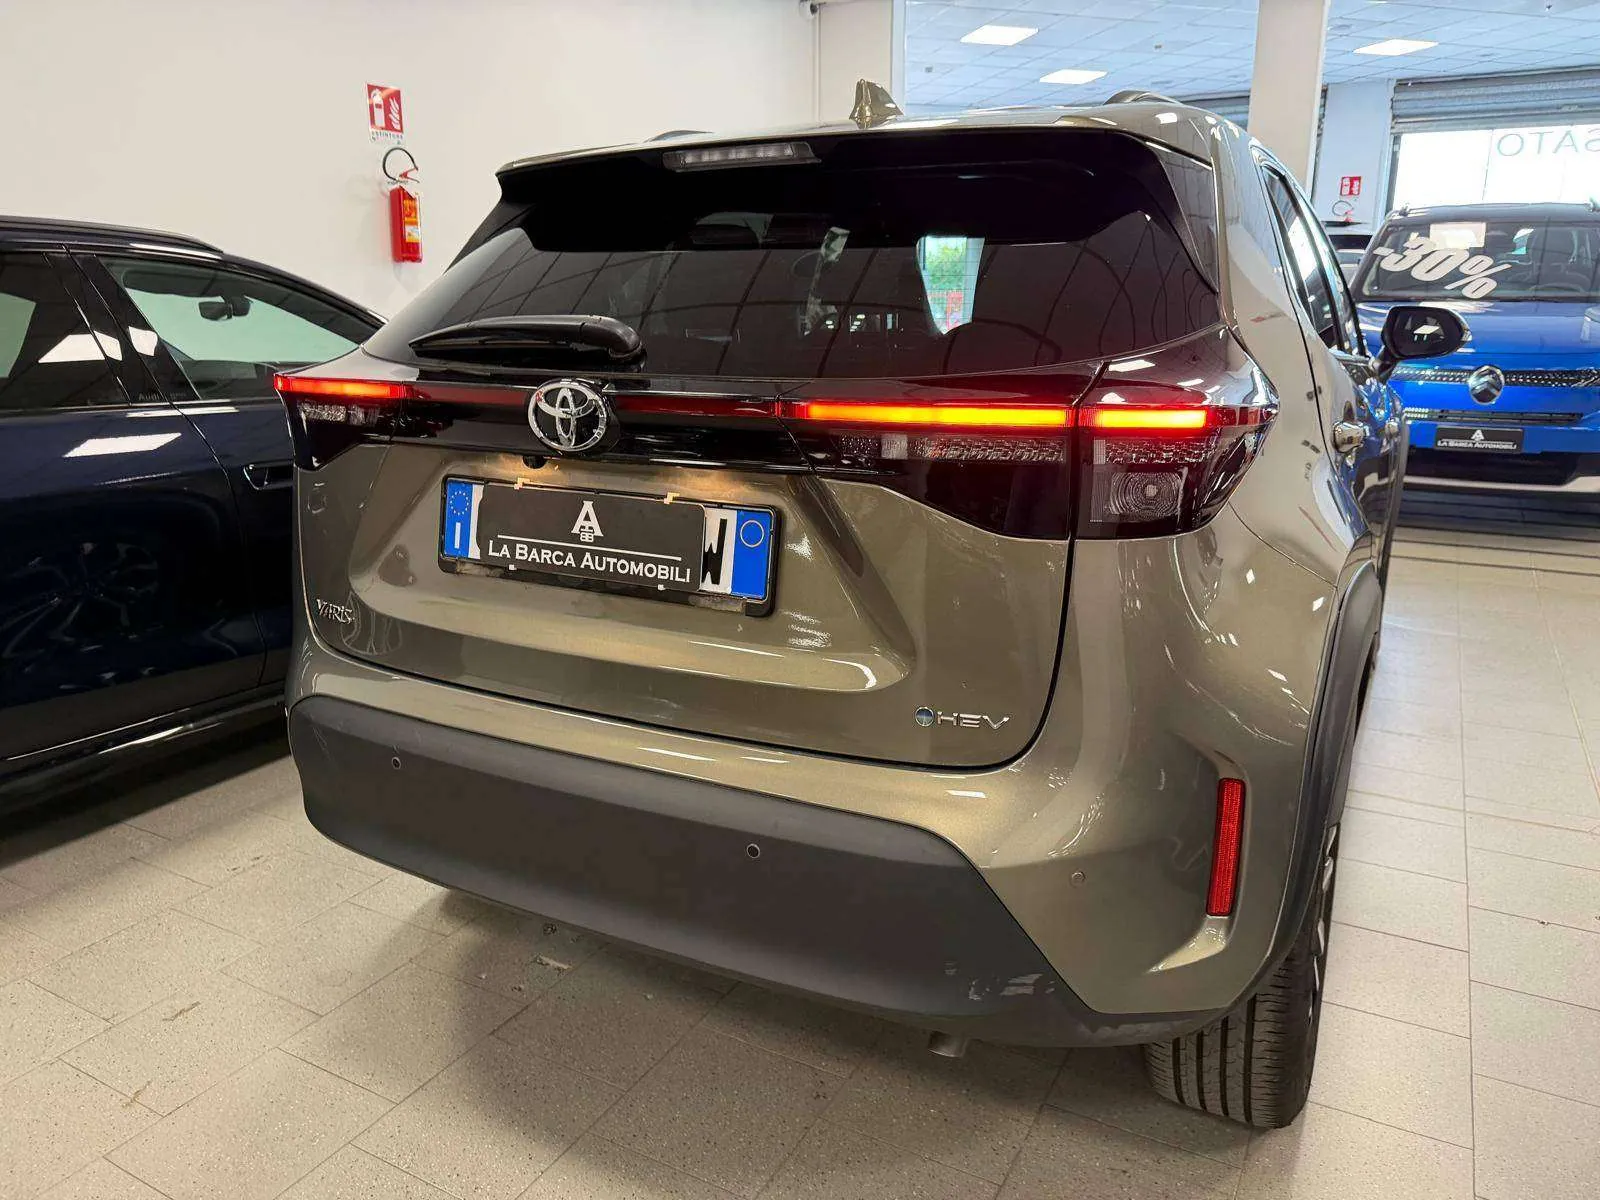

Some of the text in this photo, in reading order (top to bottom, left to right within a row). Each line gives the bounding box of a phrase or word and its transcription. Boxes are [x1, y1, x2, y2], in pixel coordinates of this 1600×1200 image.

[1373, 232, 1513, 299] -30%
[488, 540, 691, 584] LA BARCA AUTOMOBILI
[937, 711, 1010, 730] HEV
